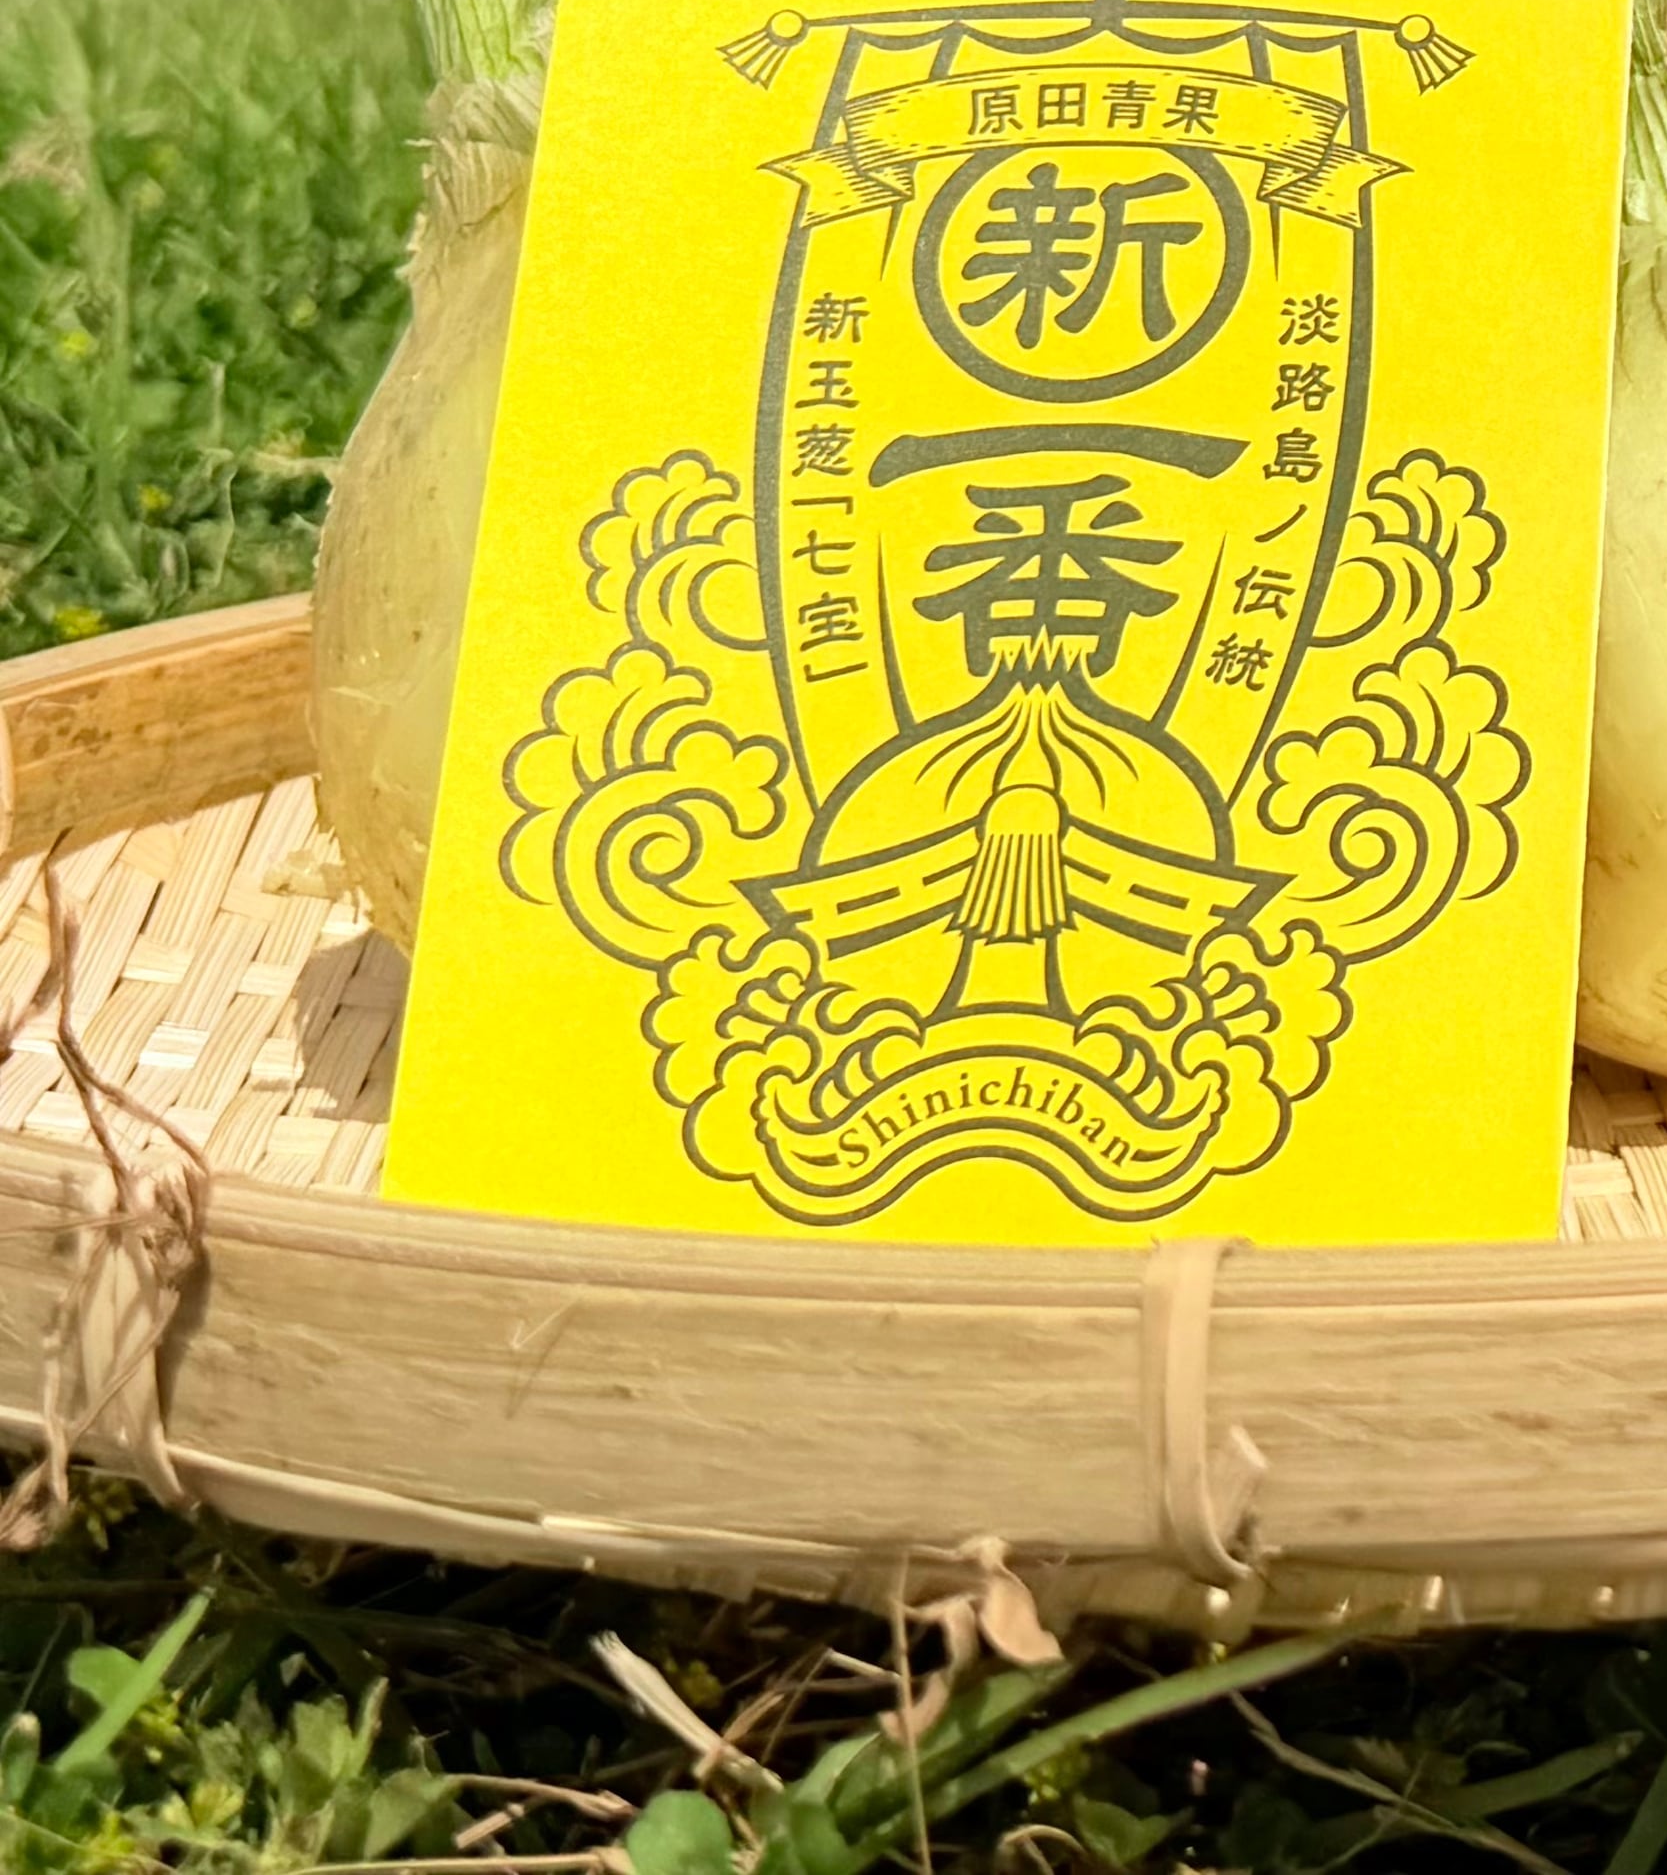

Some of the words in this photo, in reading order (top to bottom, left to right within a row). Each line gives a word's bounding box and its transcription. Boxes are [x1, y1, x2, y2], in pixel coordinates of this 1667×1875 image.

[966, 79, 1220, 136] 原田青果
[790, 291, 871, 684] 新玉葱「七宝」
[1204, 293, 1343, 693] 淡路島ノ伝統
[836, 1066, 1133, 1170] Shinichiban
